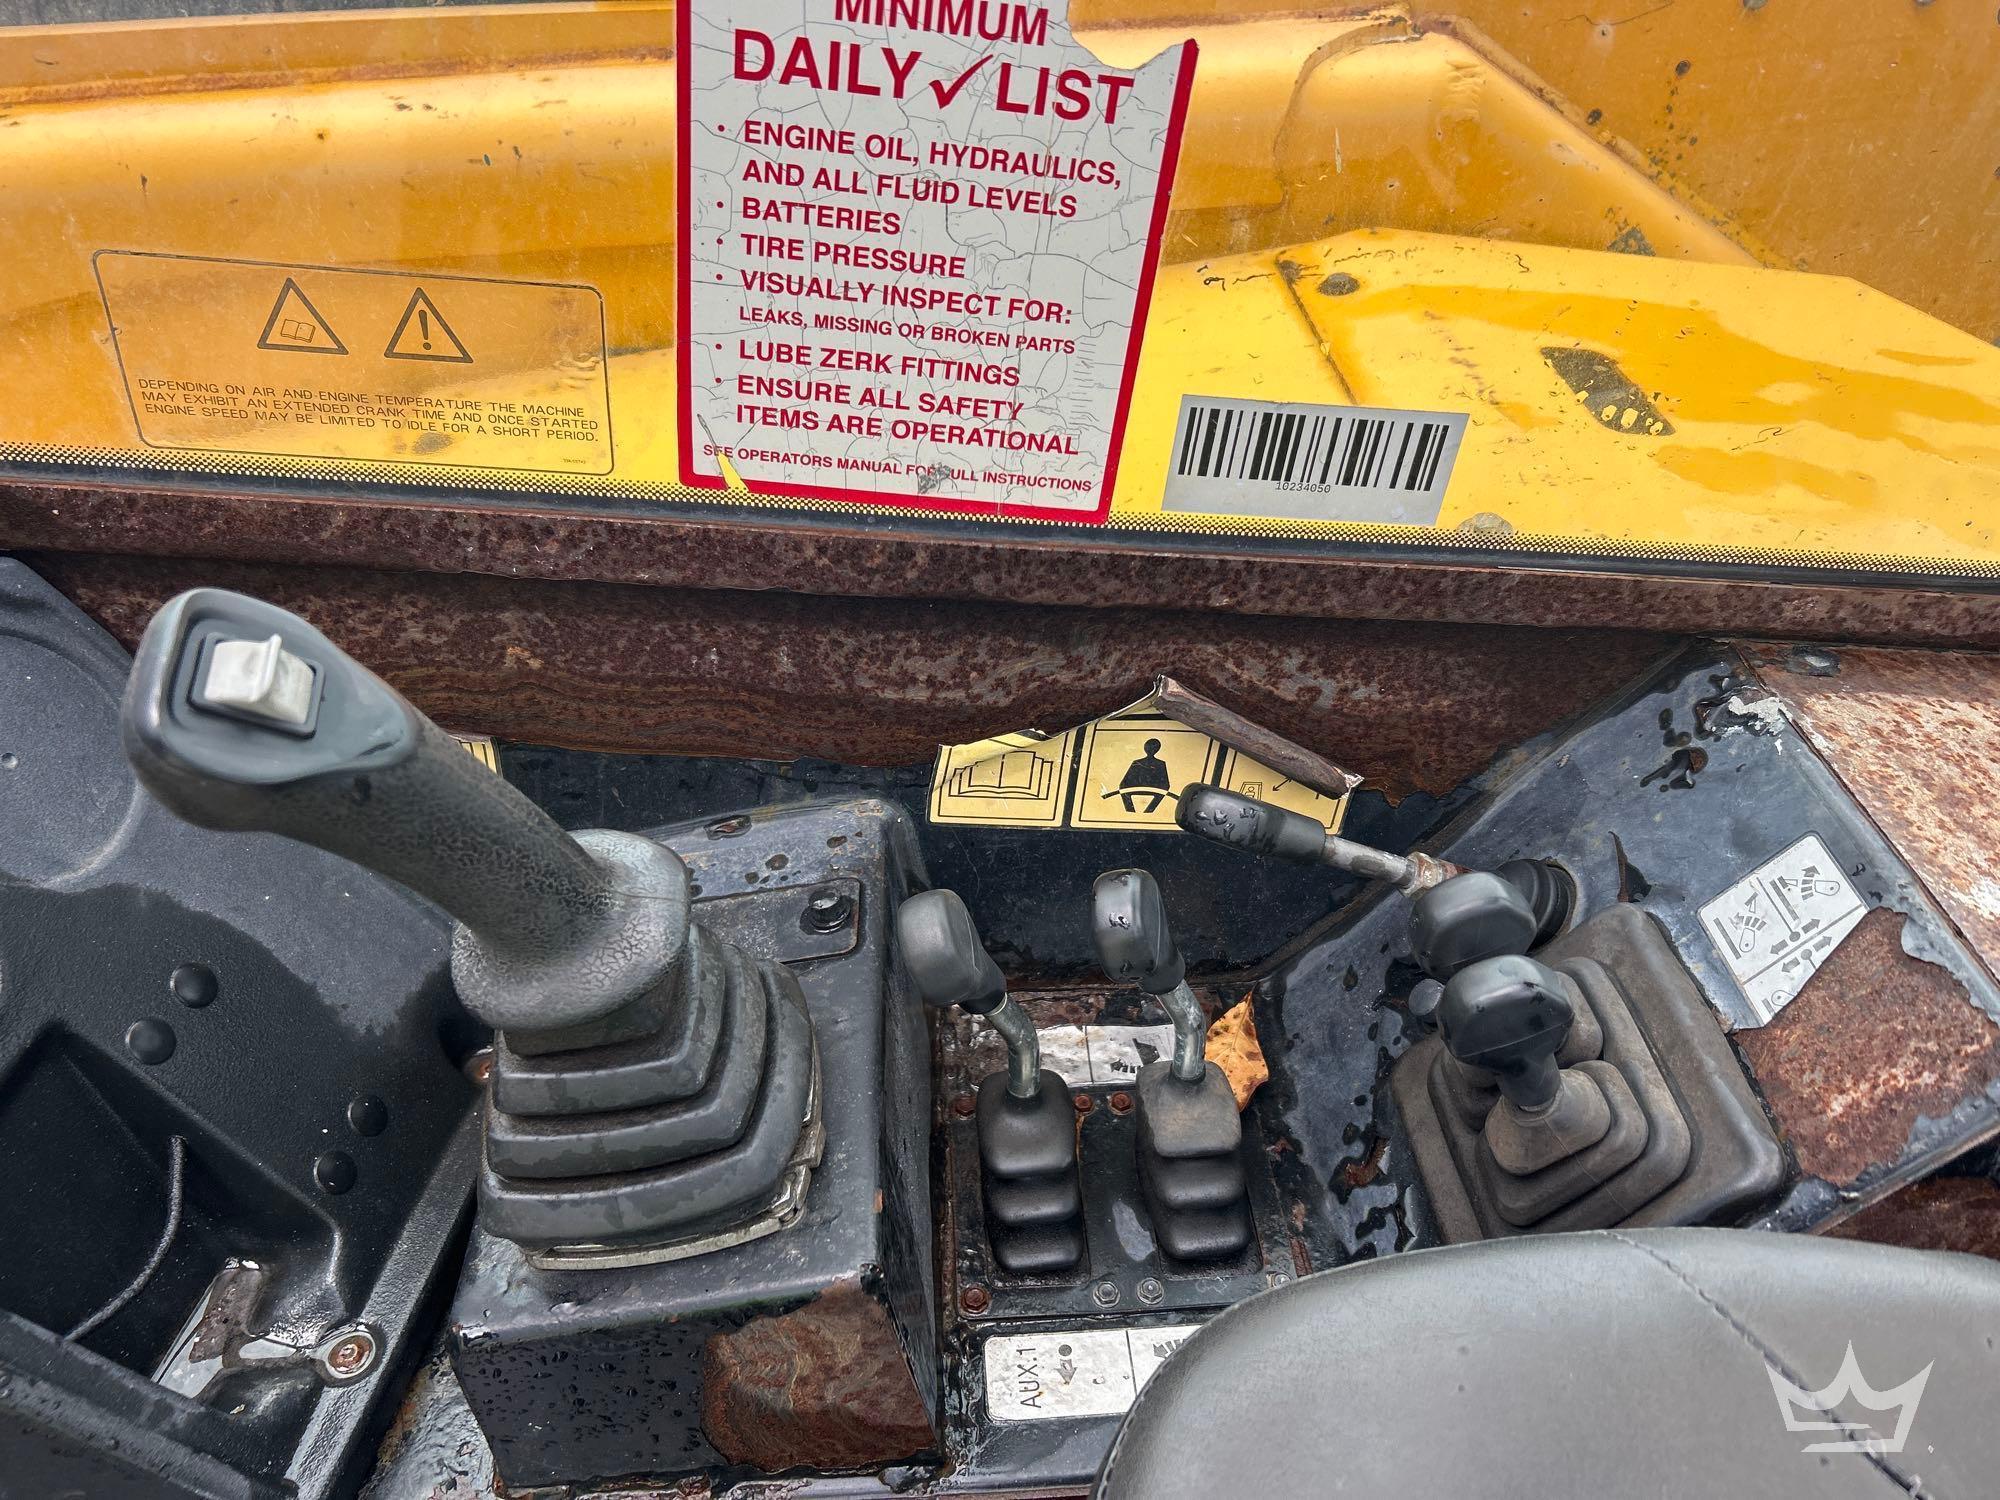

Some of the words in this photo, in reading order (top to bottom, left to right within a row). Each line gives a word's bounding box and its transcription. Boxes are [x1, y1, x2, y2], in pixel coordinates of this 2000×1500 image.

[835, 0, 1048, 45] MINIMUM
[734, 29, 921, 98] DAILY
[996, 63, 1134, 124] LIST
[745, 120, 855, 154] ENGINE
[865, 135, 918, 166] OIL,
[930, 142, 1120, 189] HYDRAULICS,
[743, 160, 804, 187] AND
[813, 168, 867, 195] ALL
[877, 175, 959, 205] FLUID
[969, 185, 1076, 217] LEVELS
[742, 197, 900, 235] BATTERIES
[741, 234, 803, 260] TIRE
[814, 242, 966, 278] PRESSURE
[741, 270, 874, 303] VISUALLY
[883, 285, 1000, 317] INSPECT
[1008, 298, 1073, 324] FOR:
[740, 307, 809, 329] LEAKS,
[815, 314, 892, 336] MISSING
[898, 323, 924, 338] OR
[932, 327, 1010, 347] BROKEN
[1016, 336, 1075, 354] PARTS
[740, 340, 812, 366] LUBE
[820, 348, 893, 374] ZERK
[902, 356, 1020, 387] FITTINGS
[138, 379, 219, 393] DEPENDING
[225, 384, 246, 396] ON
[252, 386, 276, 397] AIR
[283, 388, 314, 400] AND
[318, 391, 369, 404] ENGINE
[375, 394, 482, 411] TEMPERATURE
[490, 402, 517, 413] THE
[523, 405, 584, 418] MACHINE
[141, 391, 176, 402] MAY
[184, 393, 238, 407] EXHIBIT
[247, 399, 267, 409] AN
[273, 400, 350, 413] EXTENDED
[356, 405, 406, 418] CRANK
[413, 408, 446, 421] TIME
[452, 412, 482, 424] AND
[488, 414, 524, 426] ONCE
[530, 417, 598, 431] STARTED
[738, 375, 850, 404] ENSURE
[859, 388, 910, 411] ALL
[919, 393, 1024, 421] SAFETY
[145, 404, 196, 415] ENGINE
[202, 407, 249, 420] SPEED
[255, 411, 288, 423] MAY
[296, 413, 314, 424] BE
[320, 416, 375, 428] LIMITED
[381, 418, 401, 430] TO
[407, 420, 437, 433] IDLE
[443, 423, 469, 434] FOR
[476, 425, 487, 436] A
[493, 426, 540, 439] SHORT
[547, 430, 599, 443] PERIOD.
[737, 405, 819, 431] ITEMS
[827, 414, 882, 437] ARE
[892, 420, 1079, 455] OPERATIONAL
[703, 444, 734, 459] SEE
[737, 448, 833, 468] OPERATORS
[837, 458, 901, 475] MANUAL
[983, 472, 1092, 492] INSTRUCTIONS
[1275, 481, 1331, 494] 10234050
[1016, 1347, 1042, 1409] AUX.1
